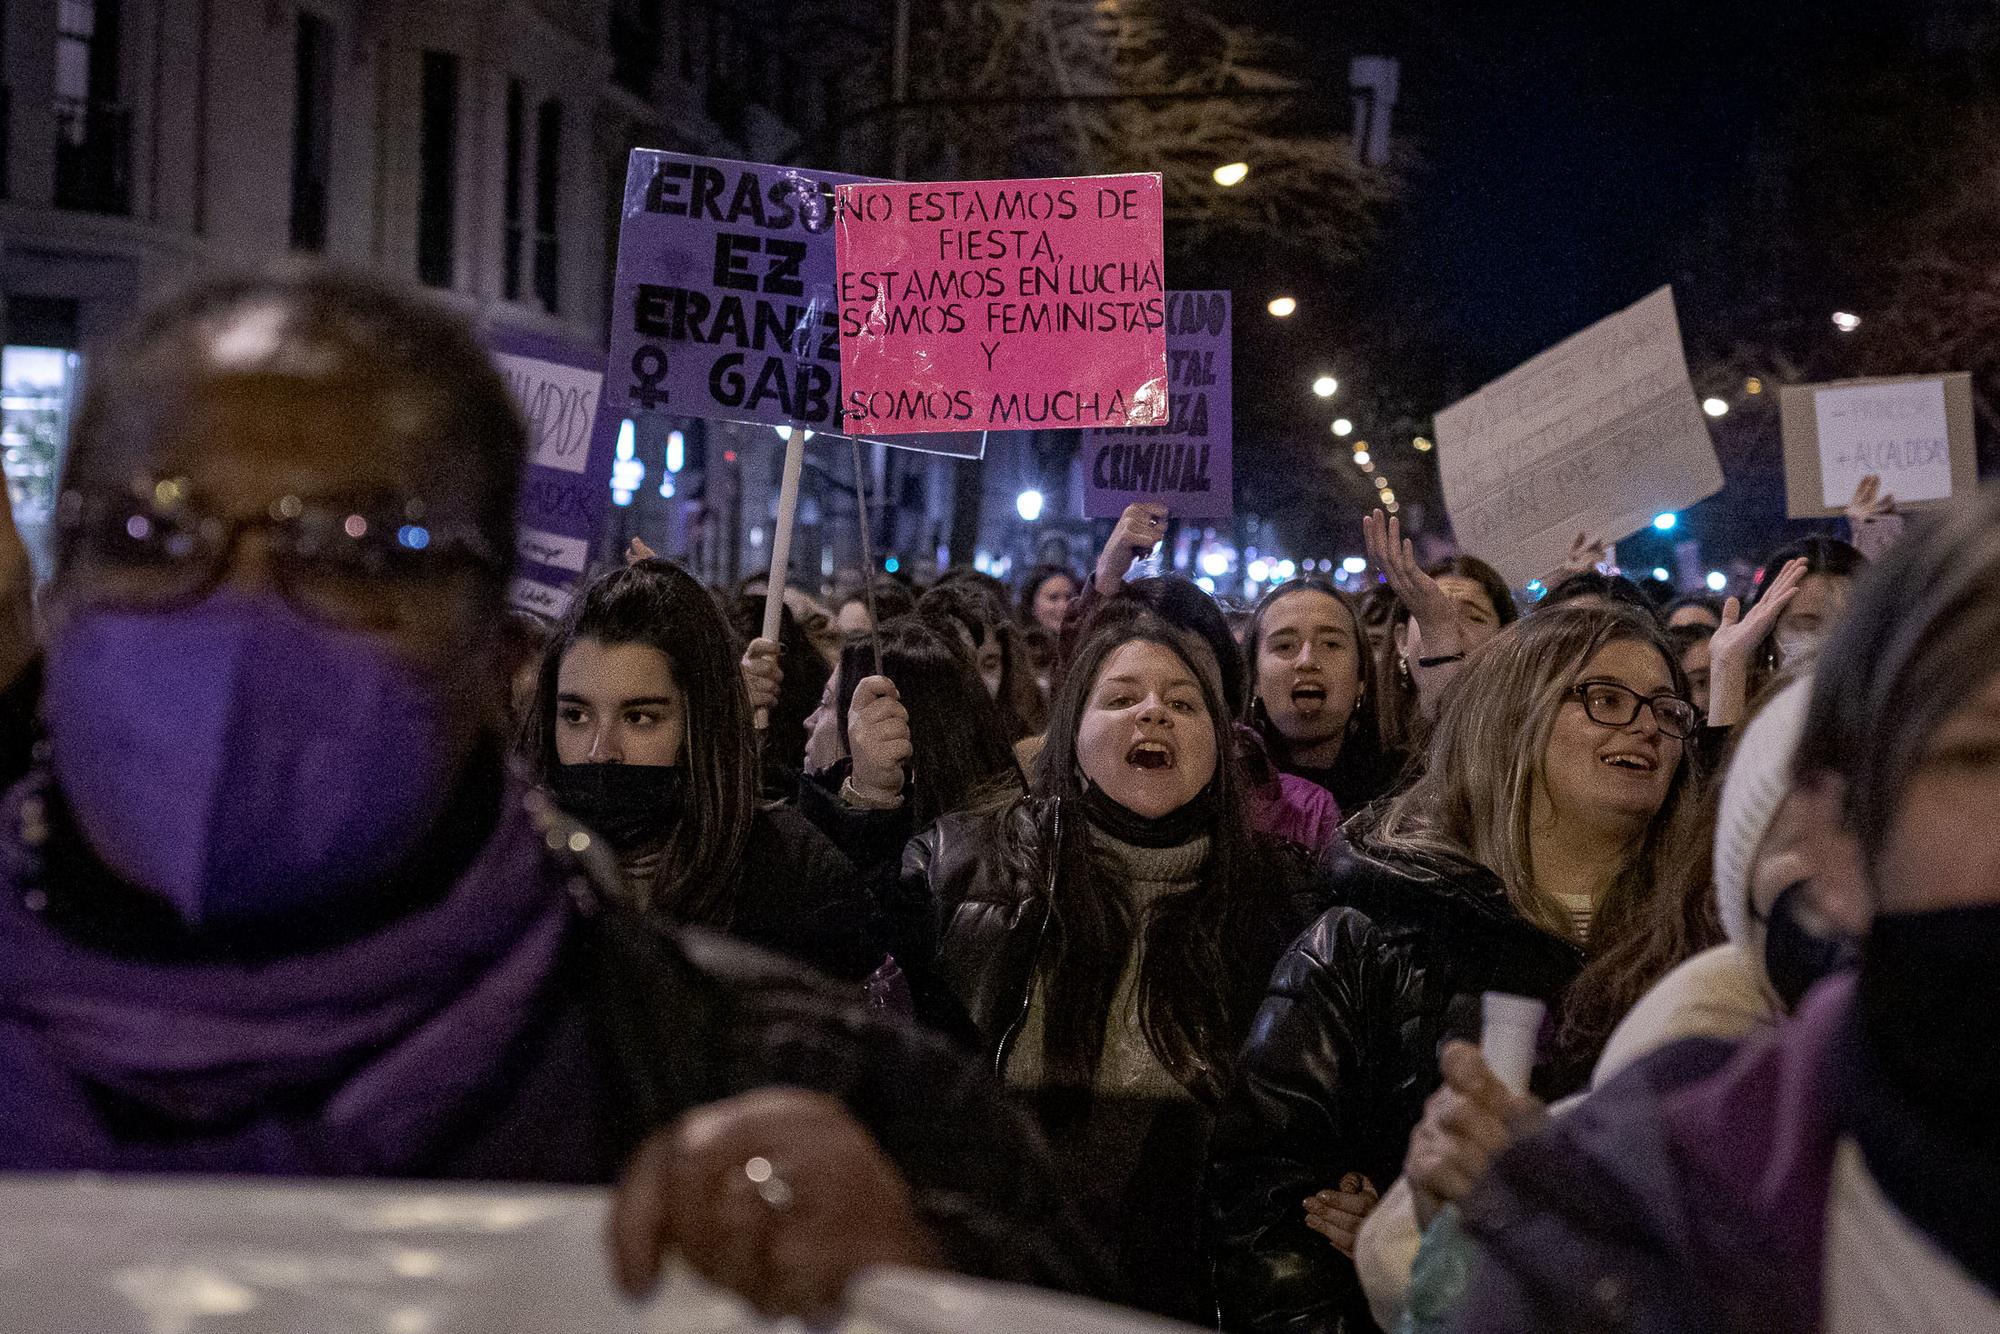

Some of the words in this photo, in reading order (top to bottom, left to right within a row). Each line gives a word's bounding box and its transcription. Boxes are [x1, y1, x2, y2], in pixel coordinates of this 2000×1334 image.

[840, 192, 892, 222] NO
[909, 188, 1078, 222] ESTAMOS
[1097, 188, 1138, 220] DE
[713, 232, 807, 296] EZ
[939, 228, 1063, 265] FIESTA,
[841, 266, 1005, 302] ESTAMOS
[1019, 266, 1059, 296] EN
[1069, 259, 1163, 295] LUCHA
[842, 303, 966, 337] SOMOS
[987, 298, 1164, 335] FEMINISTAS
[1166, 292, 1226, 337] CADO
[980, 341, 1001, 372] Y
[1166, 350, 1217, 386] TAL
[709, 352, 843, 428] GAB
[849, 389, 974, 421] SOMOS
[989, 388, 1156, 424] MUCHA
